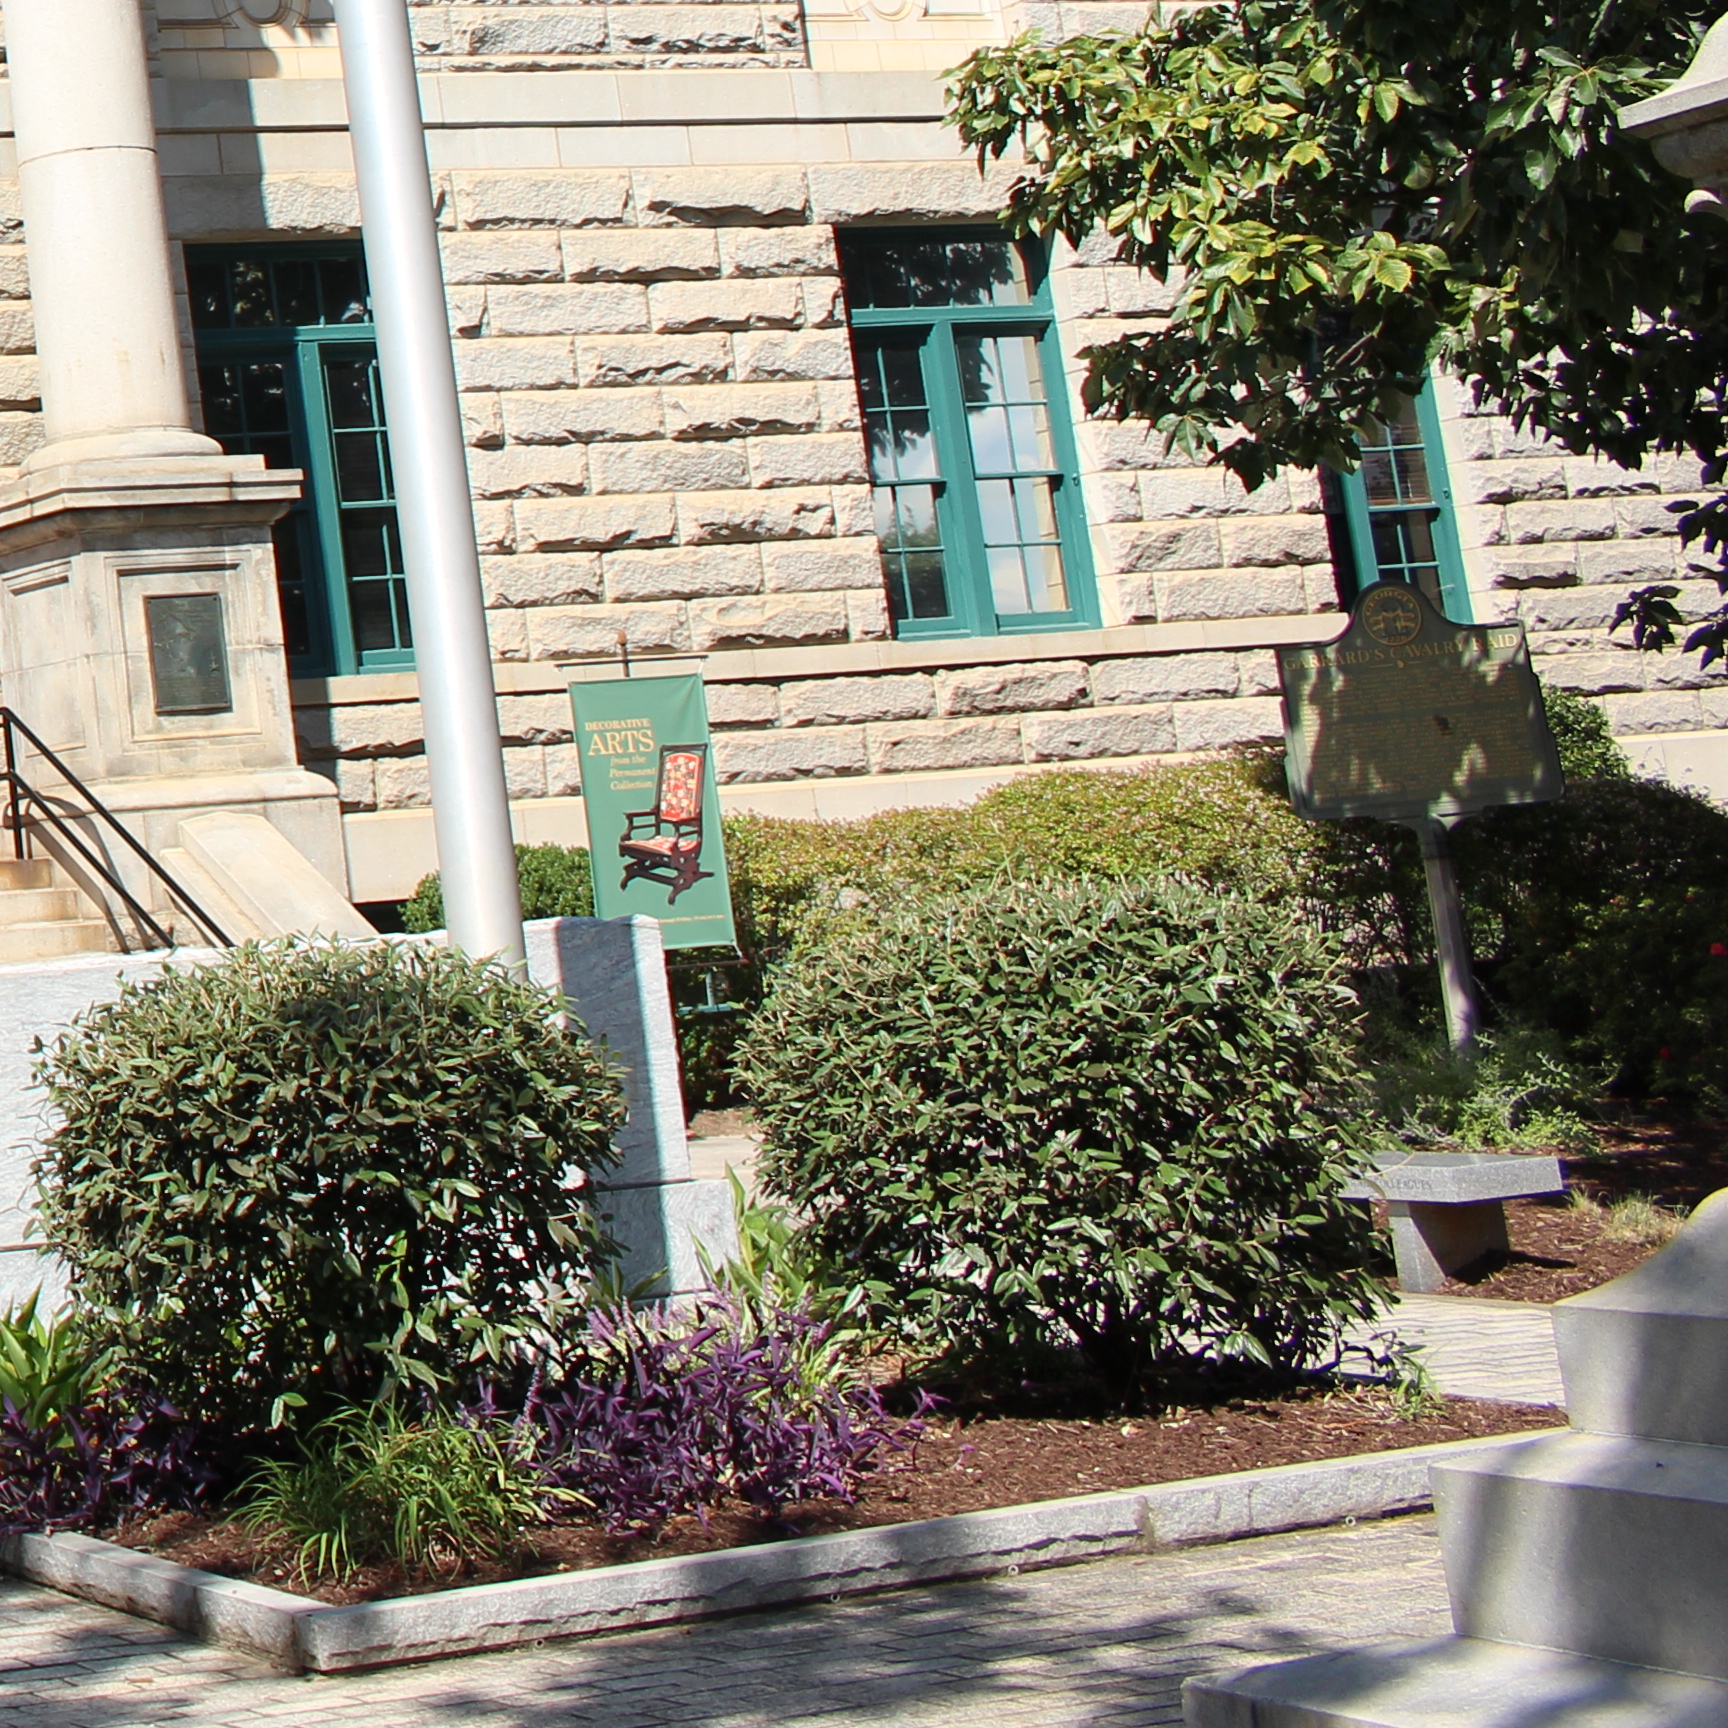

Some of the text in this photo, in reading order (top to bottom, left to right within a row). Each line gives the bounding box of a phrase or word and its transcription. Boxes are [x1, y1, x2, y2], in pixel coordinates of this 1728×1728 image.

[1365, 590, 1414, 616] GEORGIA
[1283, 633, 1517, 671] GARRARD'S CAVALRY RAID
[584, 718, 652, 731] DECORATIVE
[587, 729, 656, 756] ARTS
[610, 755, 647, 766] from the
[610, 780, 654, 790] Collection
